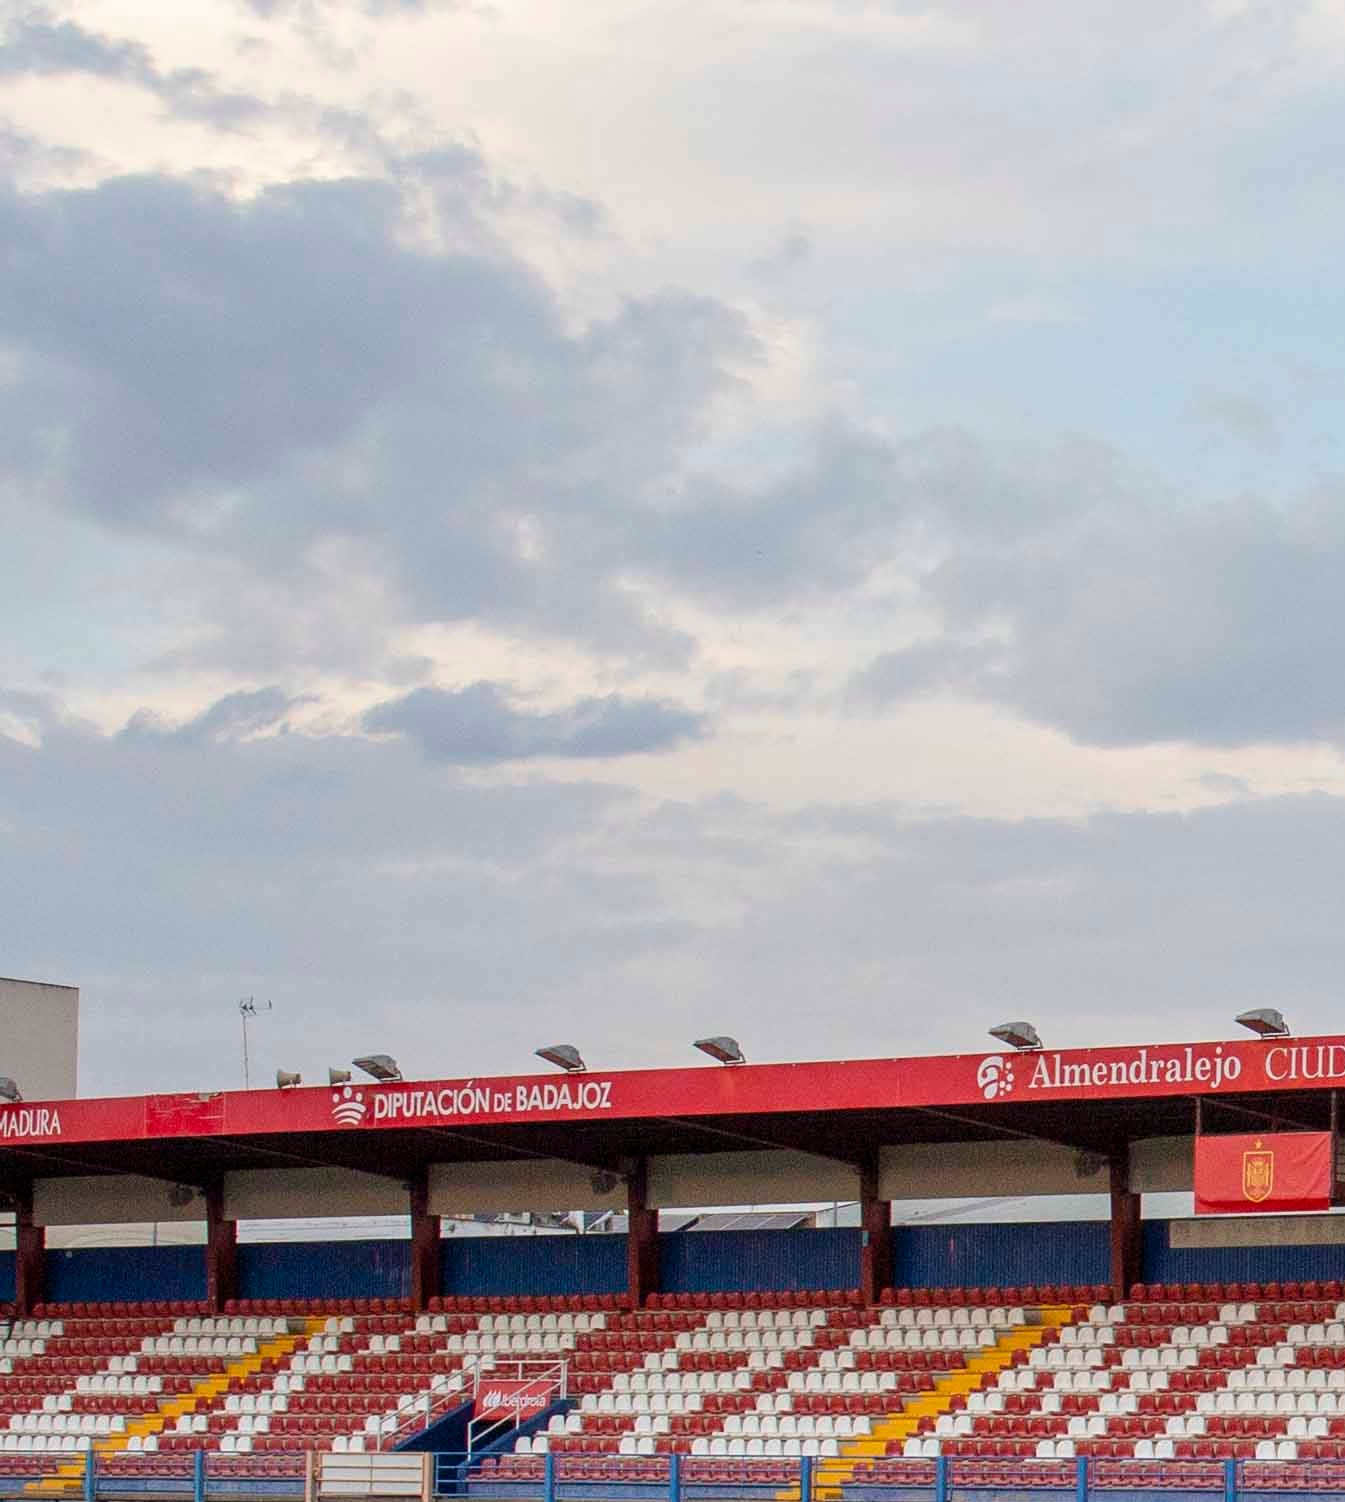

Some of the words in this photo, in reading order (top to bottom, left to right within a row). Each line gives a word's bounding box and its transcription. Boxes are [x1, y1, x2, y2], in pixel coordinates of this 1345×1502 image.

[1029, 1046, 1241, 1089] Almendralejo
[374, 1080, 490, 1119] DIPUTACIÓN
[515, 1081, 611, 1112] BADAJOZ
